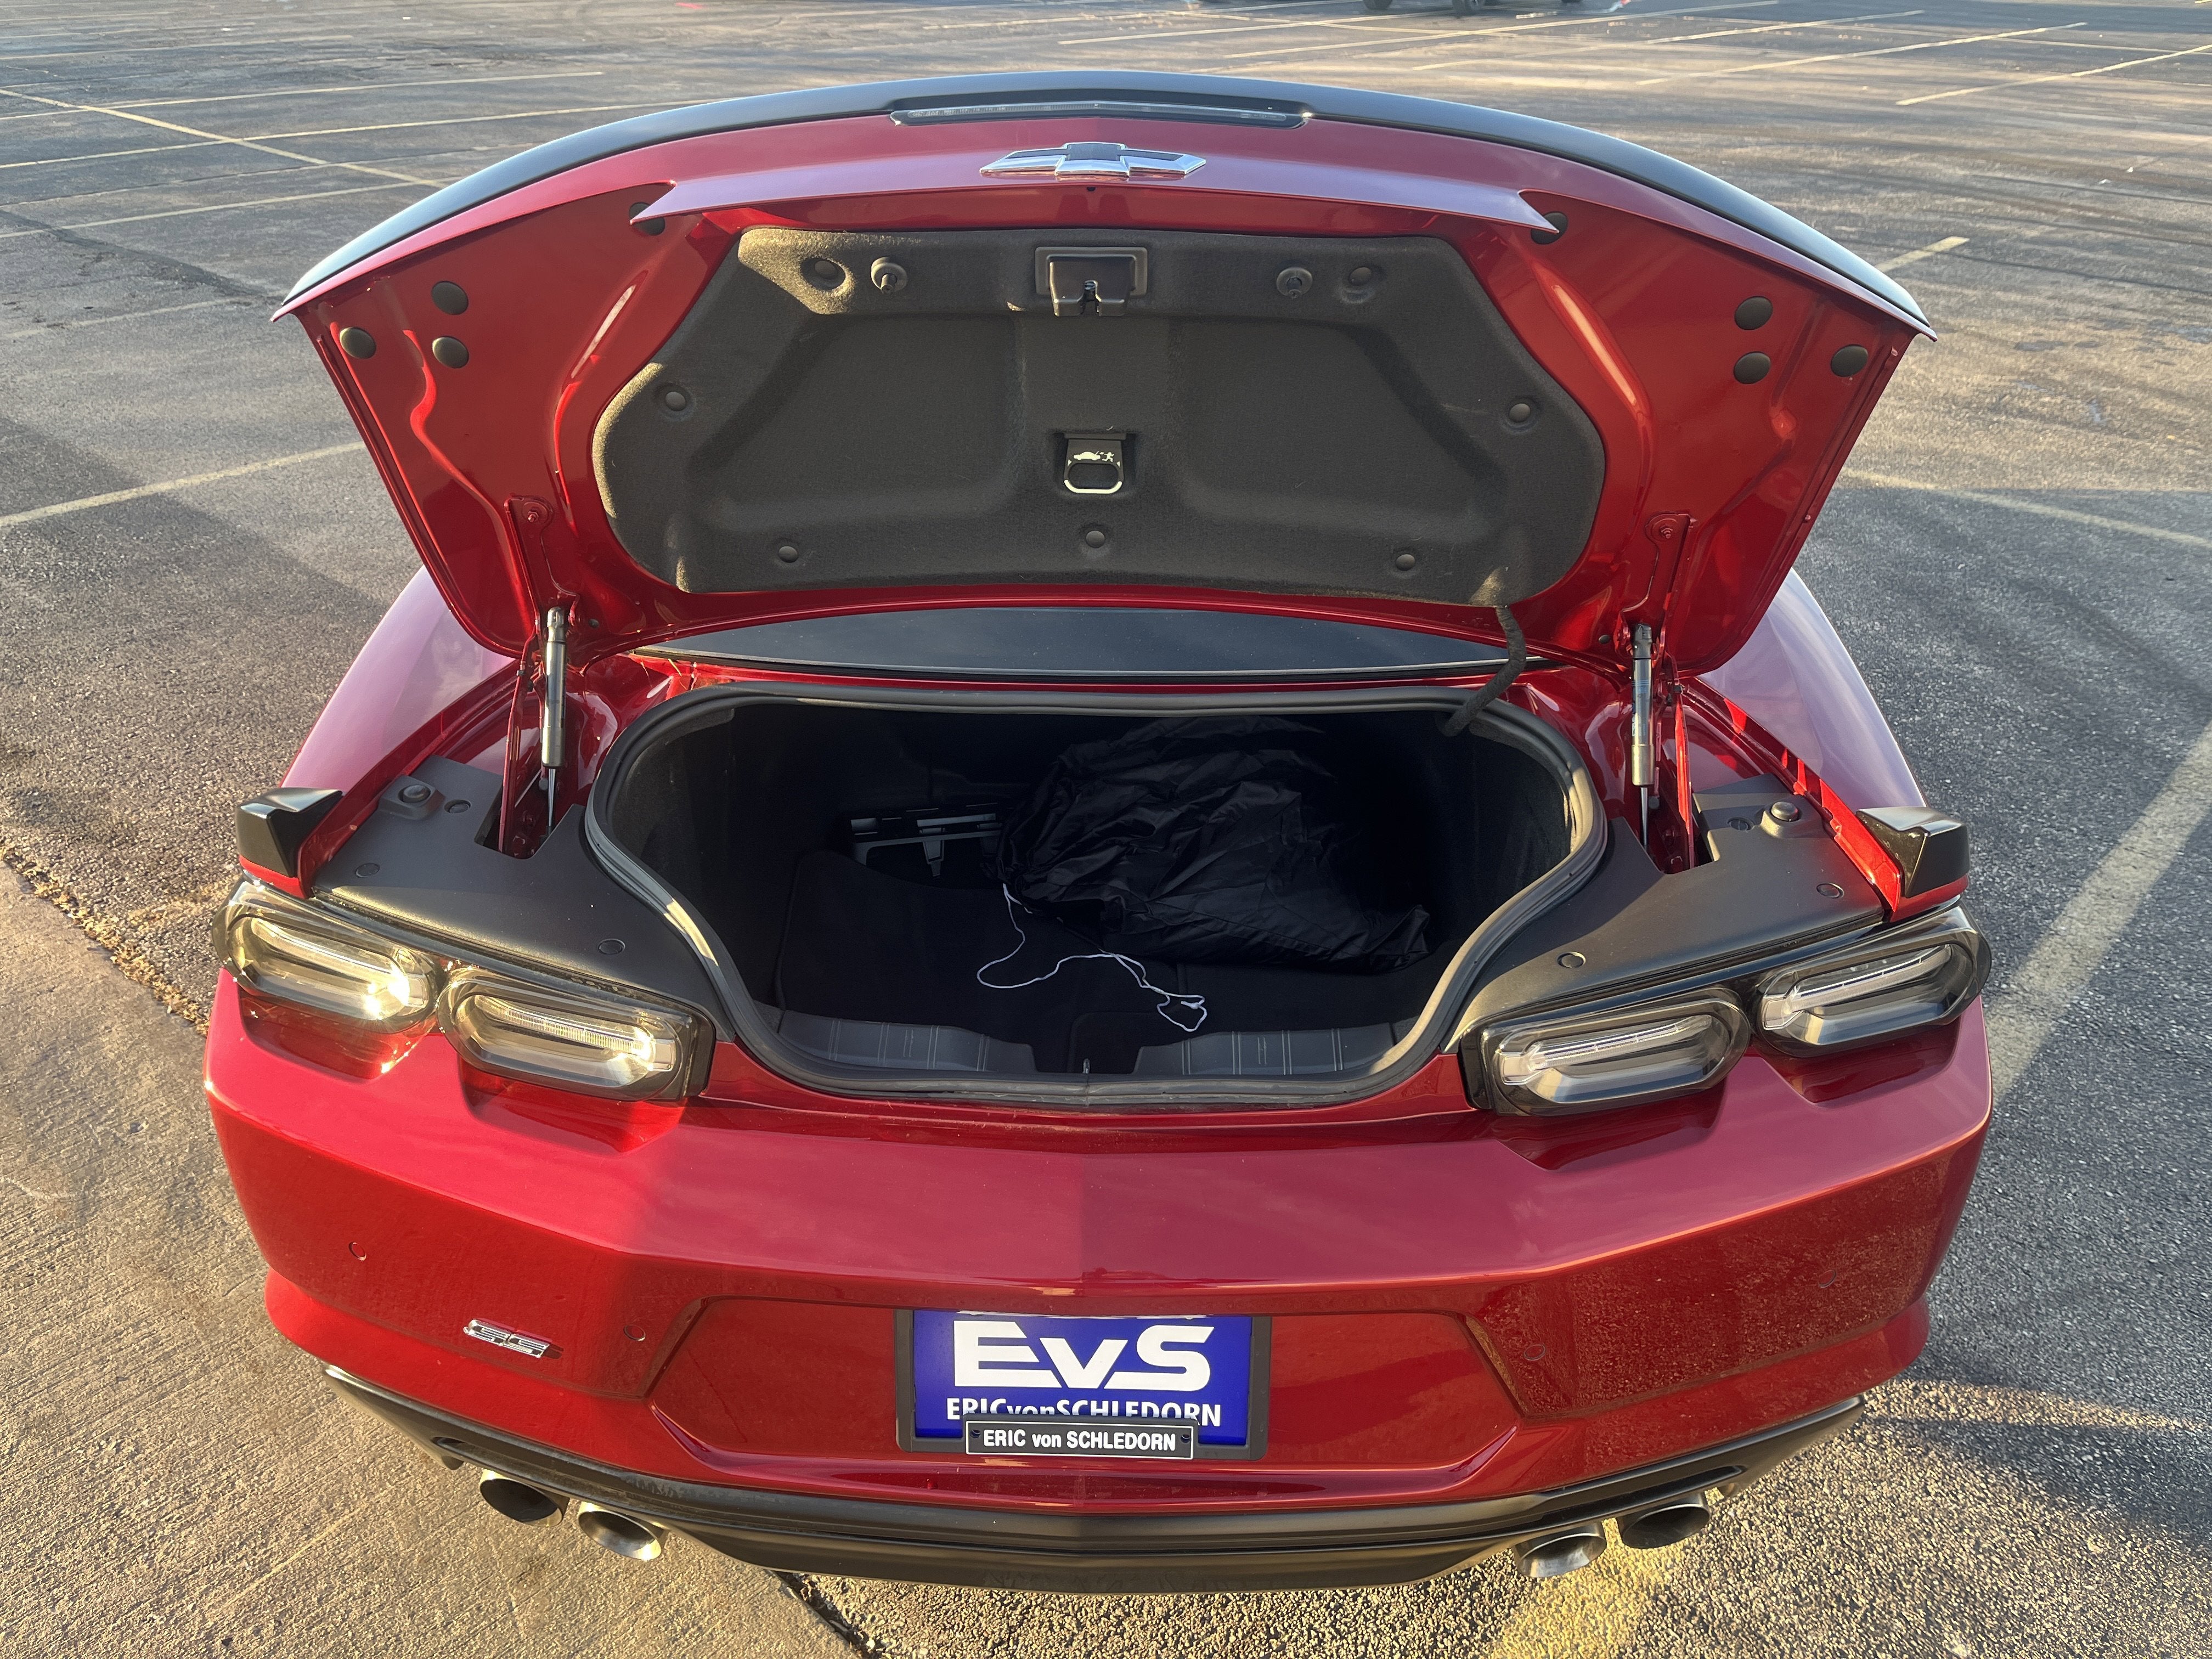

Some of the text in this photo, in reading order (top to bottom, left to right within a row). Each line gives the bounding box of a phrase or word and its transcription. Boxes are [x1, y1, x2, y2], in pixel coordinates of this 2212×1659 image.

[984, 1429, 1176, 1451] ERIC von SCHLEDORN
